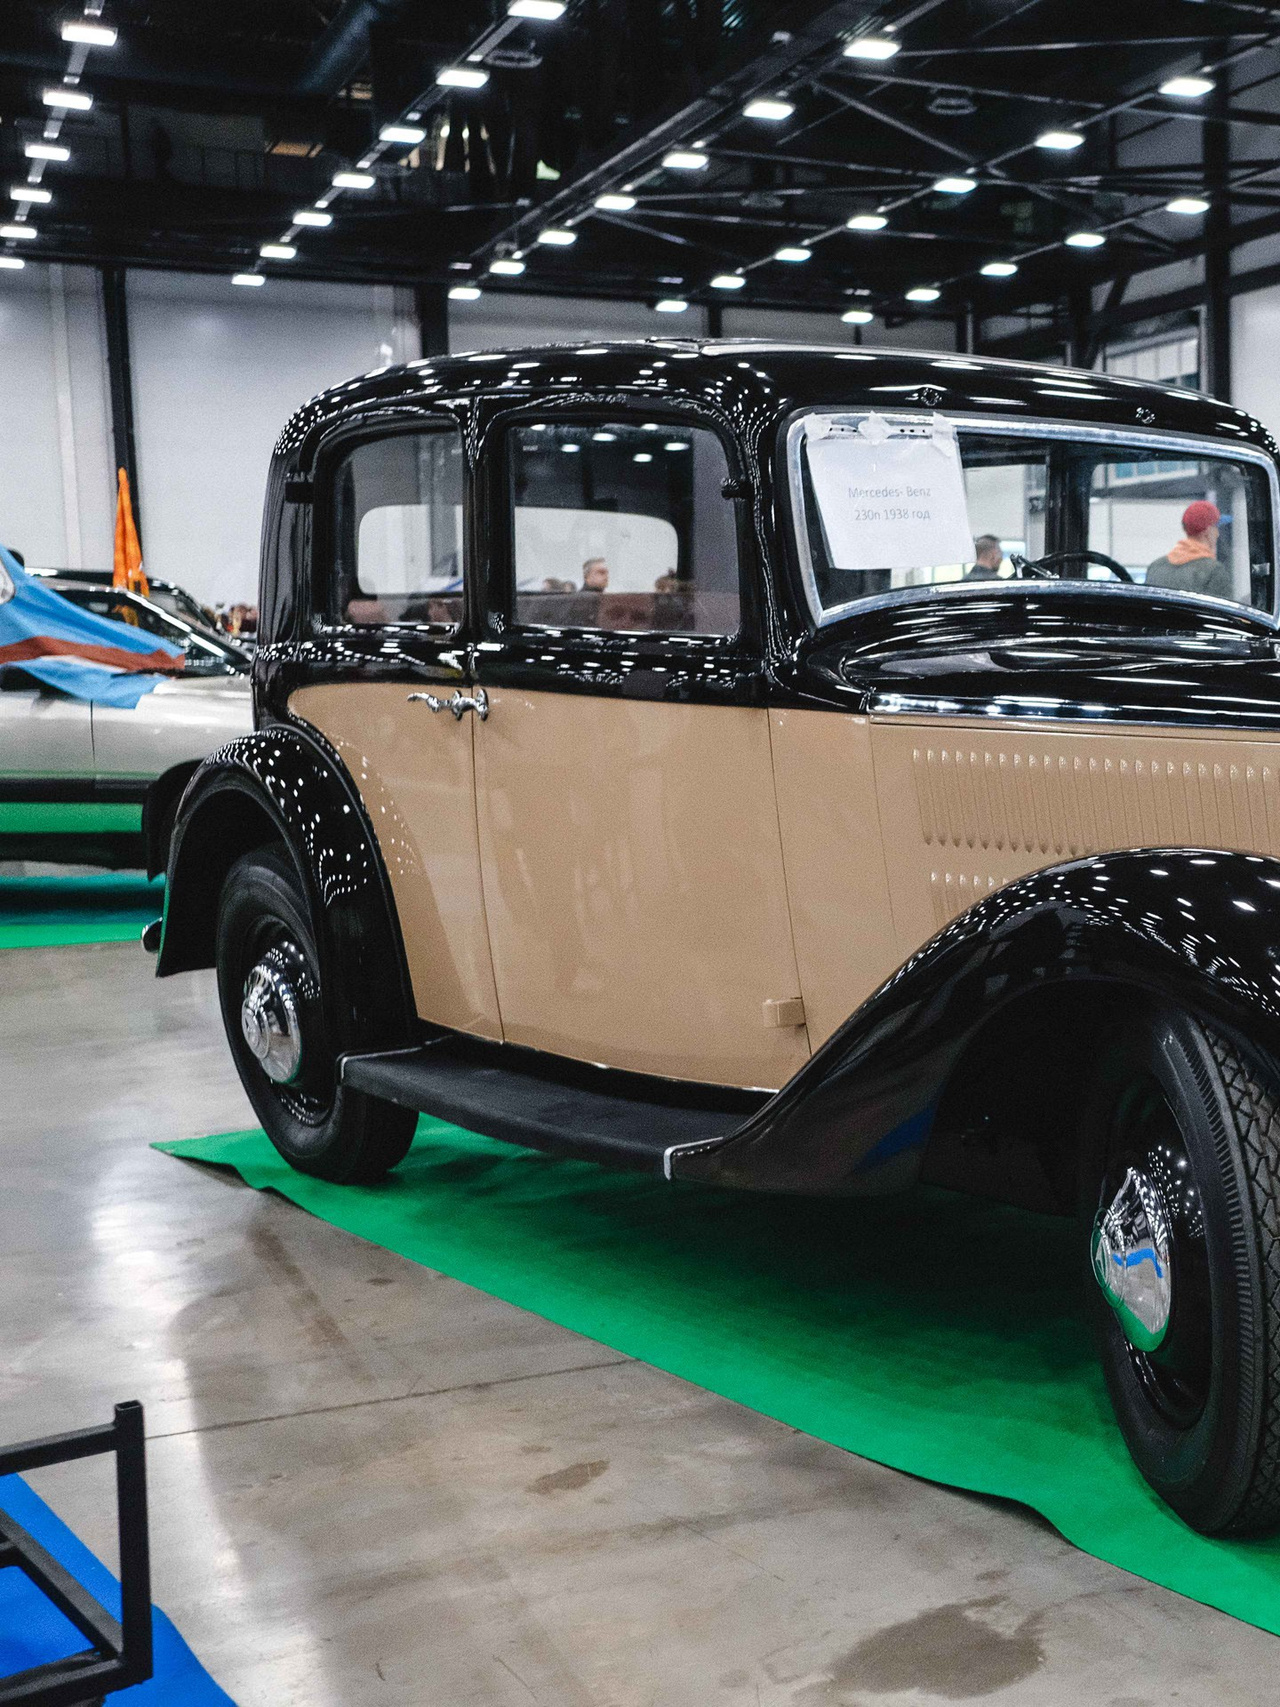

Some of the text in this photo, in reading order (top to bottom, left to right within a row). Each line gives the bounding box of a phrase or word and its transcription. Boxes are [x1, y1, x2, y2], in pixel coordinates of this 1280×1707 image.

[848, 486, 931, 498] Mercedes- Benz
[884, 508, 910, 520] 1938
[912, 510, 931, 521] год
